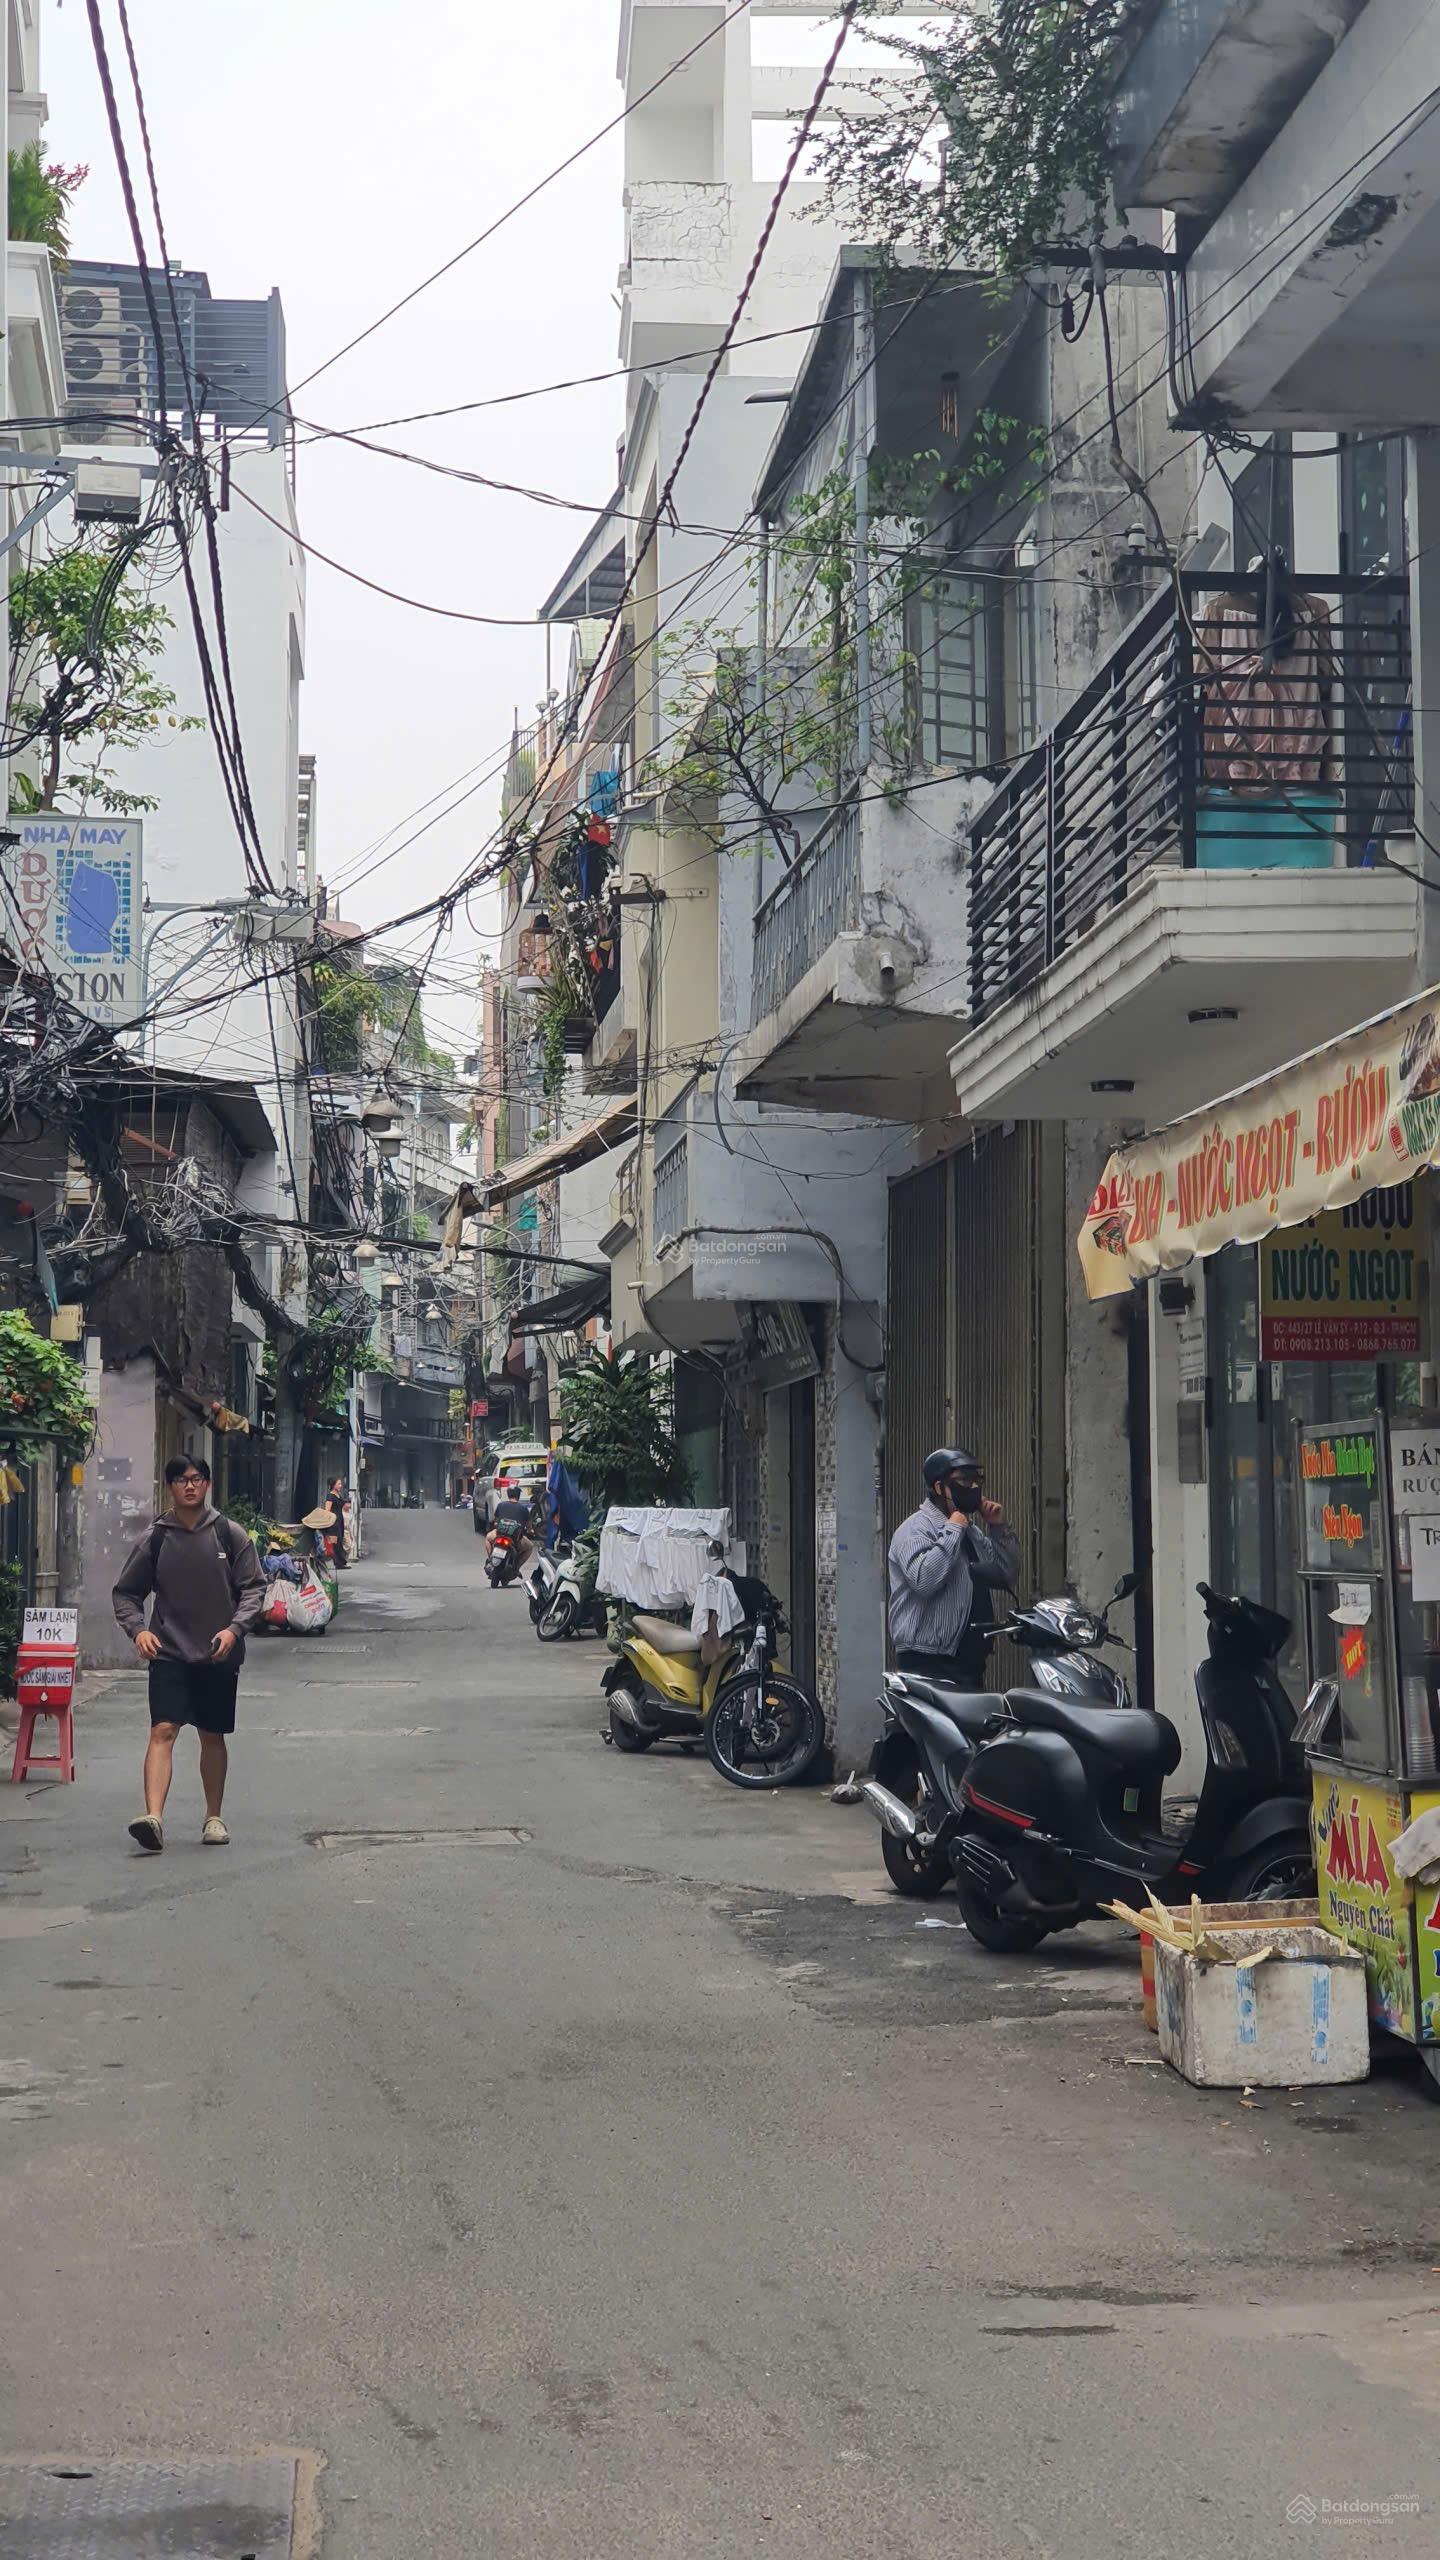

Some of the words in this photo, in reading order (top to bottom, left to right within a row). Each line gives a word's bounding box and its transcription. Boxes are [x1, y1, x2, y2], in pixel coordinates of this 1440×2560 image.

[1272, 1238, 1340, 1302] NƯỚC
[1349, 1248, 1415, 1313] NGỌT
[37, 1628, 63, 1642] 10K
[1327, 1796, 1390, 1899] MÍA
